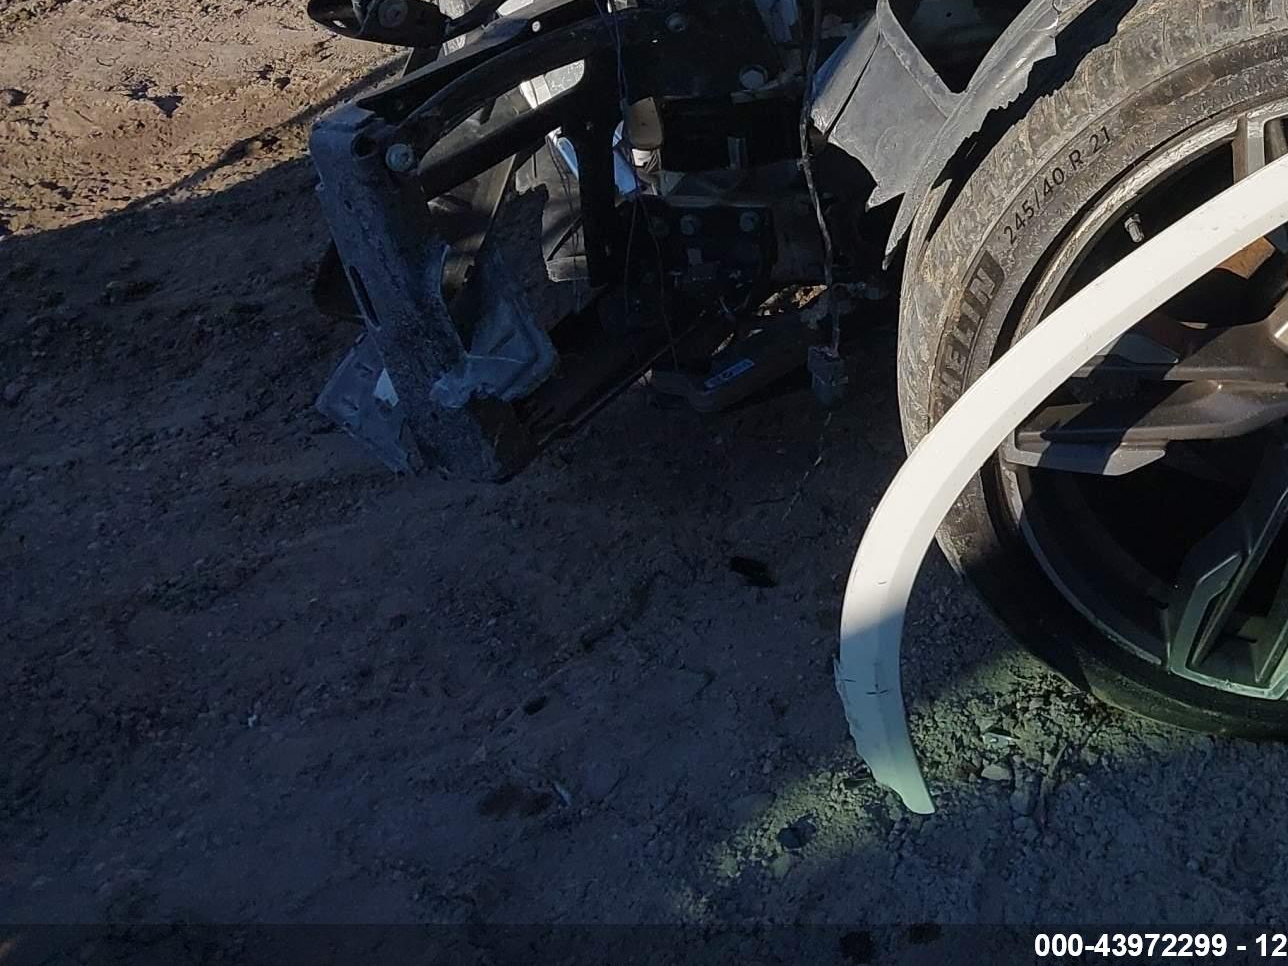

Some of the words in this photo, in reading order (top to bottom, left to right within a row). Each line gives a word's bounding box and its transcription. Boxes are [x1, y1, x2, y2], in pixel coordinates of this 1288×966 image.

[1003, 167, 1065, 246] 245/40
[1068, 149, 1084, 171] R
[1089, 126, 1112, 154] 21
